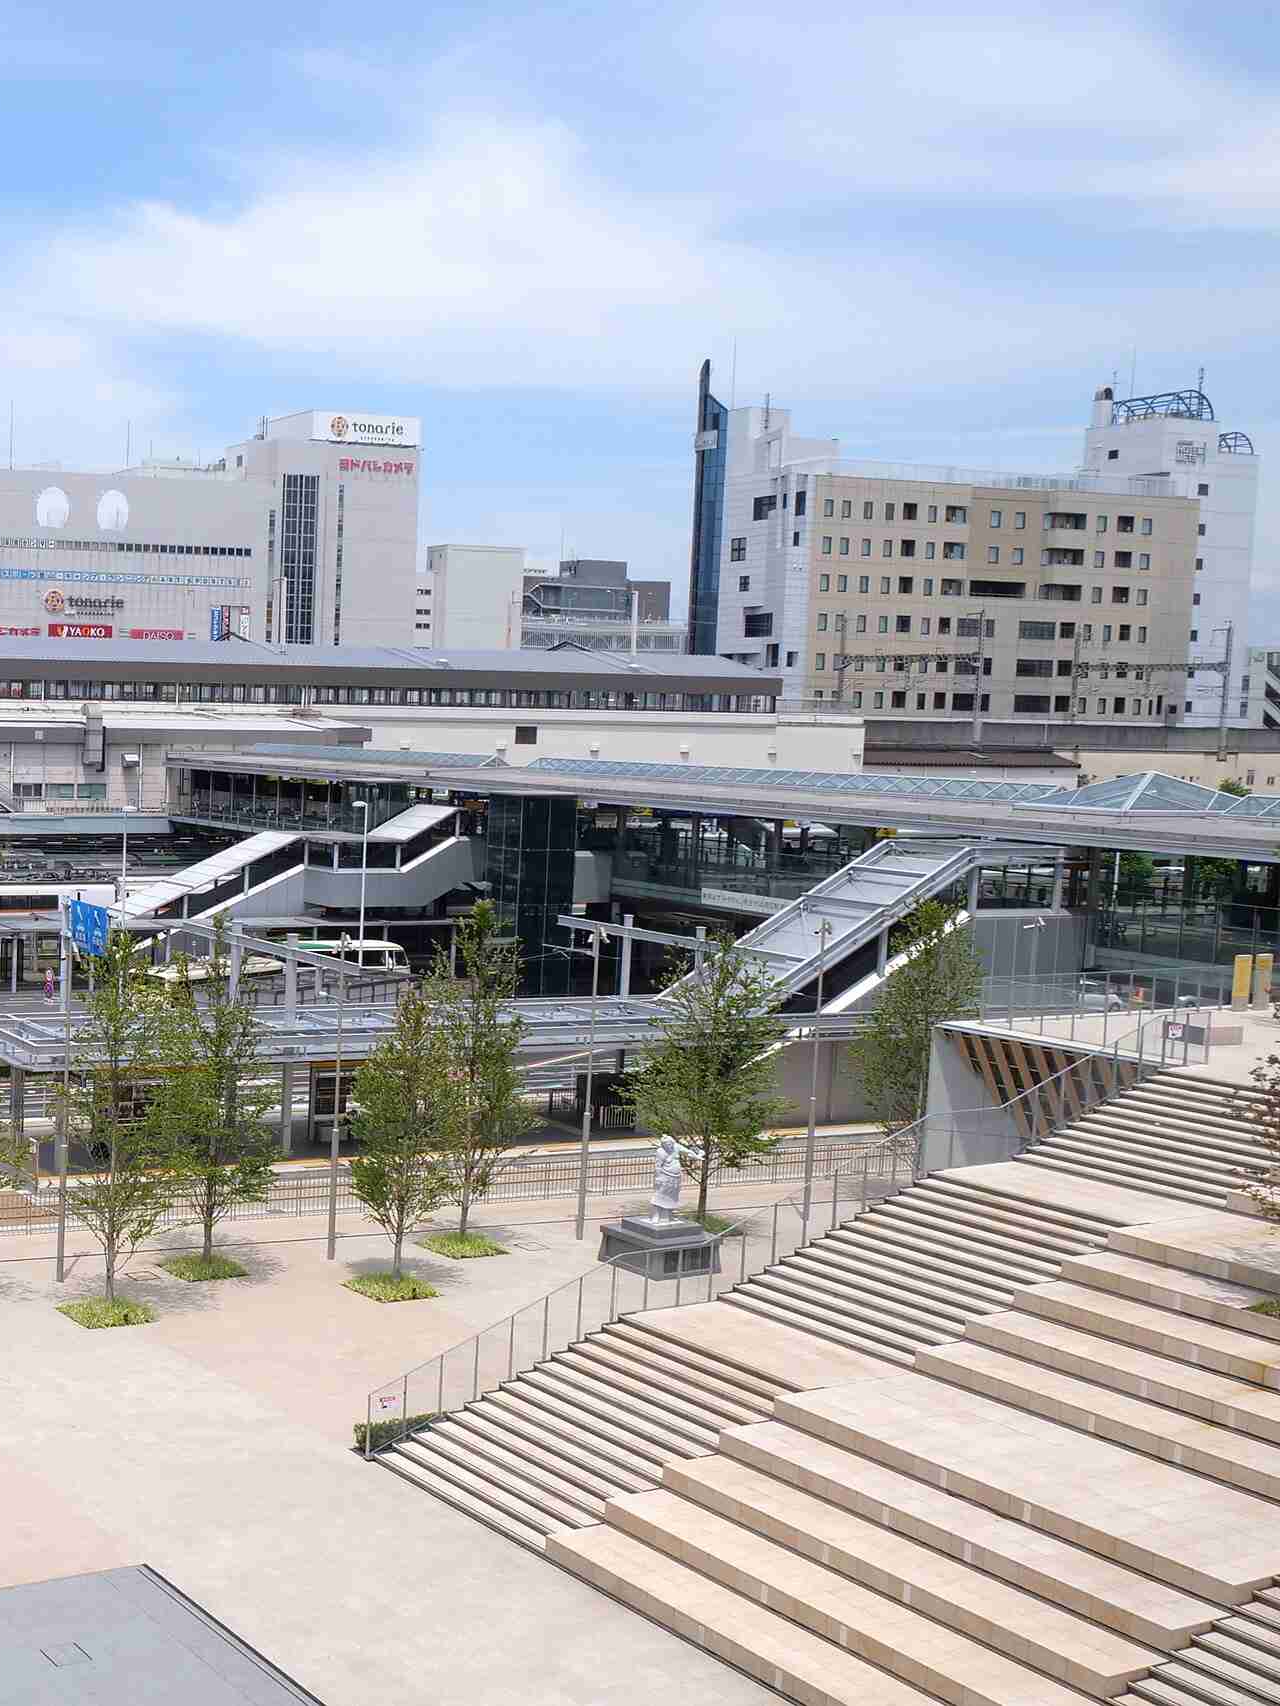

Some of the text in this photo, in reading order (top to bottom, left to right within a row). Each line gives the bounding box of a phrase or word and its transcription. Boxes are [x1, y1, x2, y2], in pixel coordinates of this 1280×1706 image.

[351, 421, 404, 435] tonarie
[338, 458, 415, 475] ヨドバシカメラ
[66, 594, 125, 609] tonarie
[69, 625, 105, 637] YAOKO
[142, 631, 176, 641] DAISO
